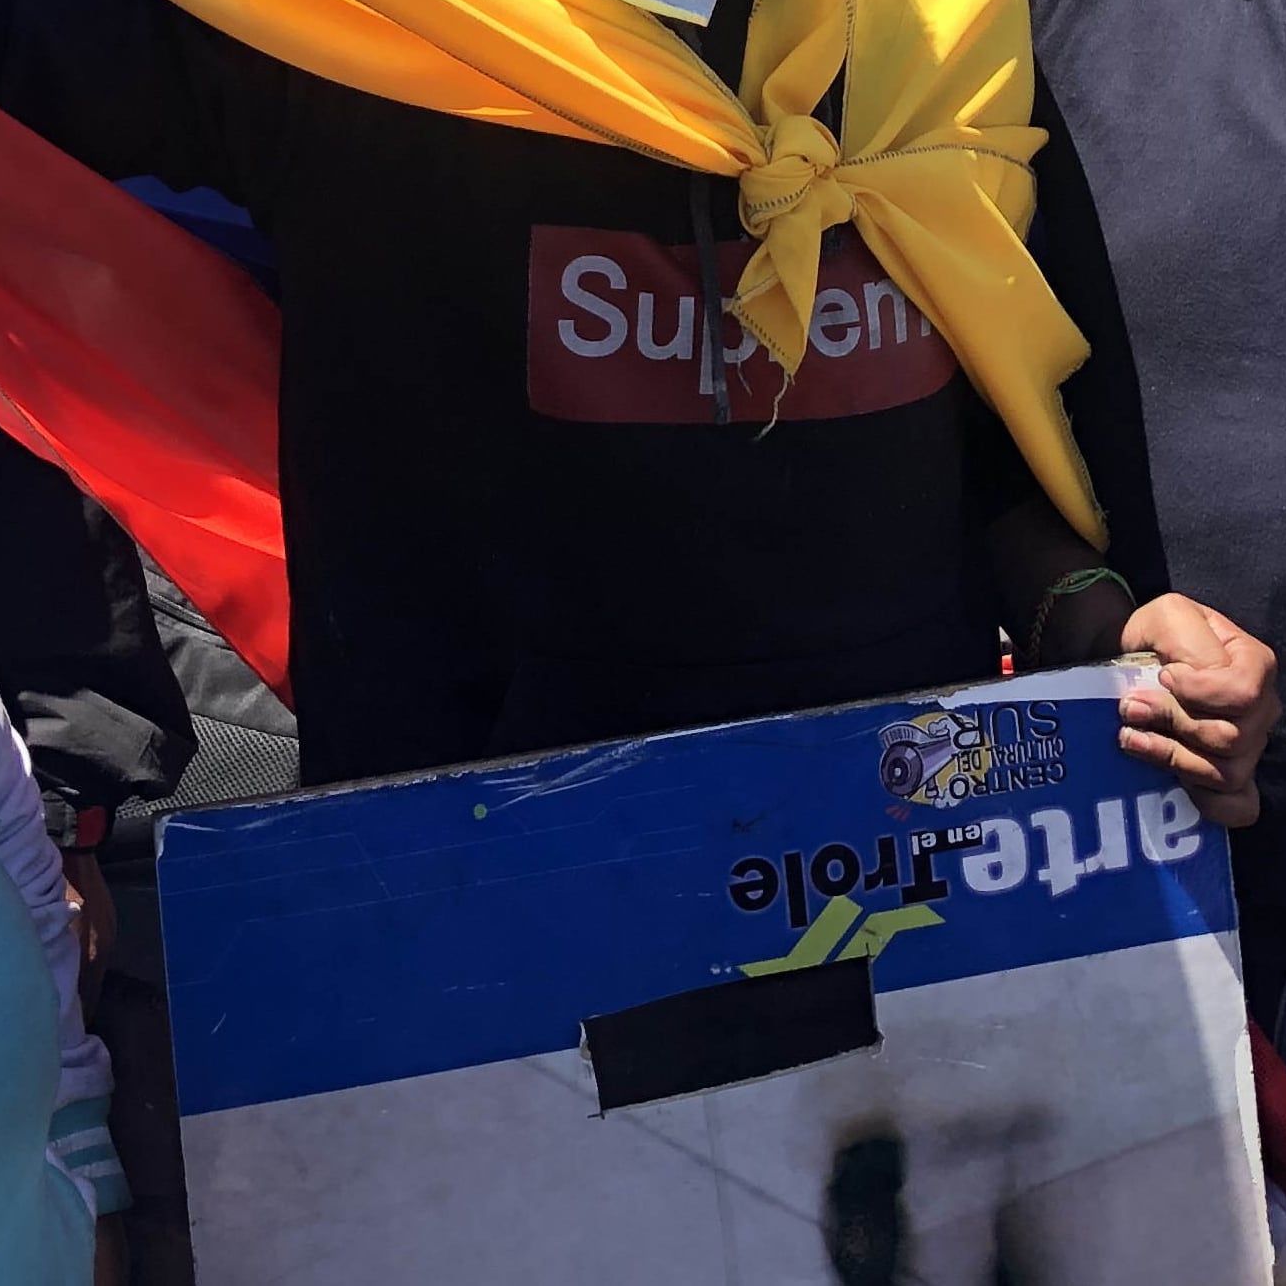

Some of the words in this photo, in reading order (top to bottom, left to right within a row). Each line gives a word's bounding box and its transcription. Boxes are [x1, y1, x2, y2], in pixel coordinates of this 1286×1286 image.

[945, 699, 1061, 750] SUR
[951, 749, 982, 773] DEL
[986, 738, 1064, 768] CULTURAL
[948, 762, 1064, 800] CENTRO
[912, 829, 937, 855] el
[947, 823, 983, 845] en
[962, 787, 1202, 898] arte
[729, 835, 949, 928] Trole
